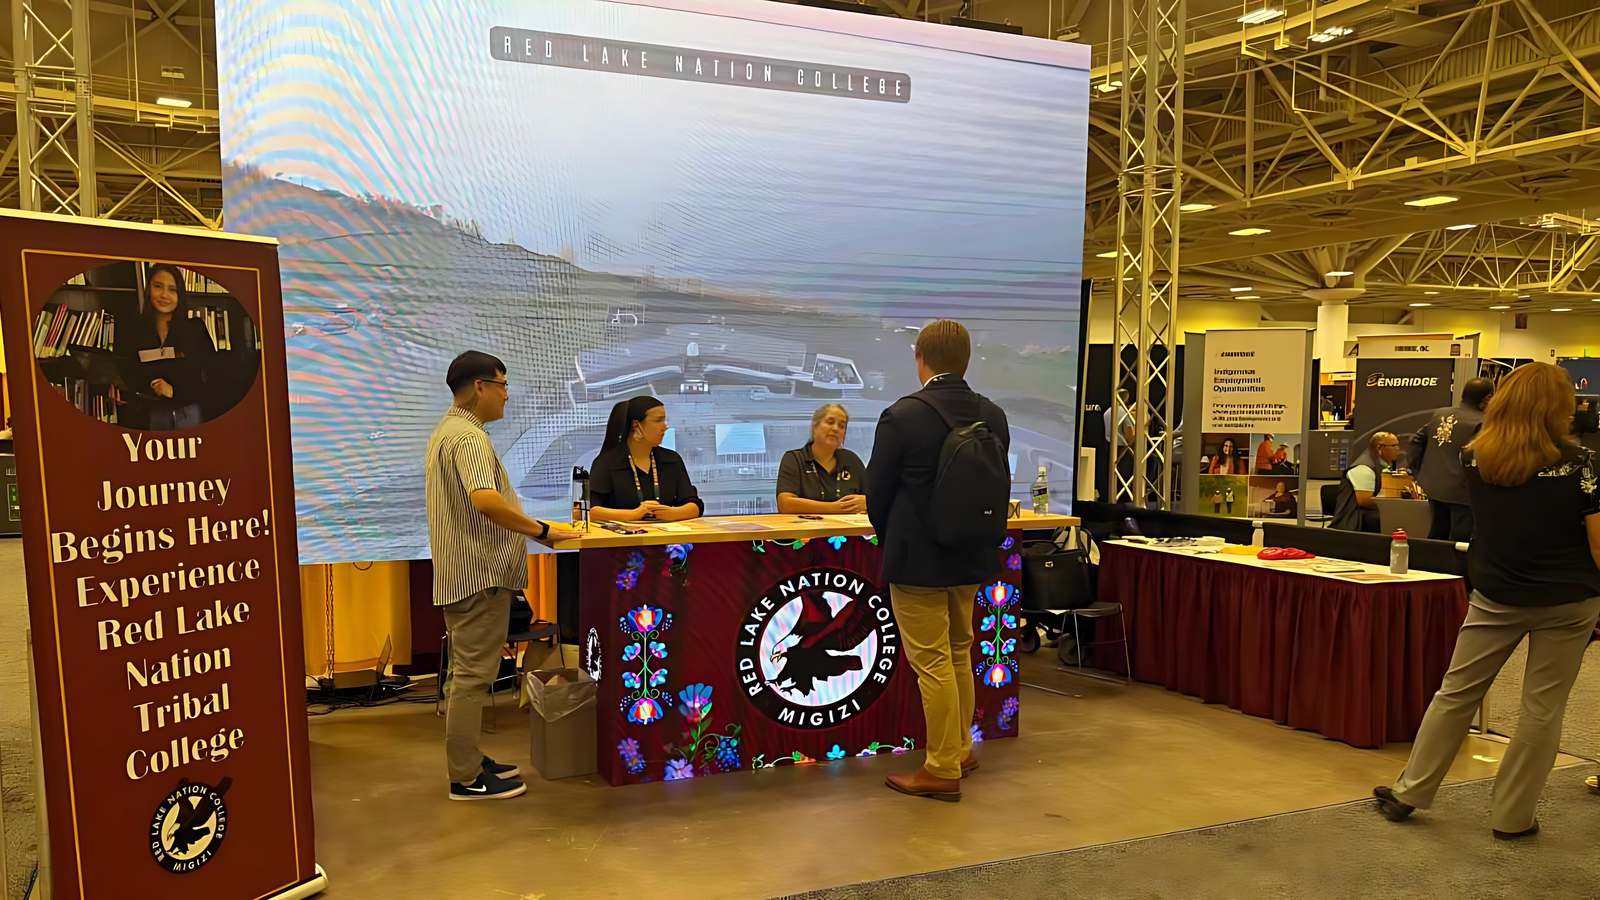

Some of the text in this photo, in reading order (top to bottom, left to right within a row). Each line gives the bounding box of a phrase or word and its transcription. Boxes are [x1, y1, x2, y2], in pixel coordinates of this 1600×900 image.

[504, 36, 901, 97] RED LAKE NATION COLLEGE
[1377, 377, 1438, 387] ENBRIDGE
[122, 433, 202, 462] Your
[97, 478, 231, 511] Journey
[51, 509, 269, 564] Begins Here!
[76, 559, 260, 608] Experience
[97, 600, 250, 650] Red Lake
[739, 572, 896, 697] RED LAKE NATION COLLEGE
[126, 647, 231, 690] Nation
[133, 683, 230, 732] Tribal
[778, 698, 861, 726] MIGIZI
[126, 727, 244, 780] College
[151, 806, 167, 836] LAKE
[167, 785, 207, 805] NATION
[209, 792, 226, 839] COLLEGE
[173, 850, 212, 871] MIGIZI
